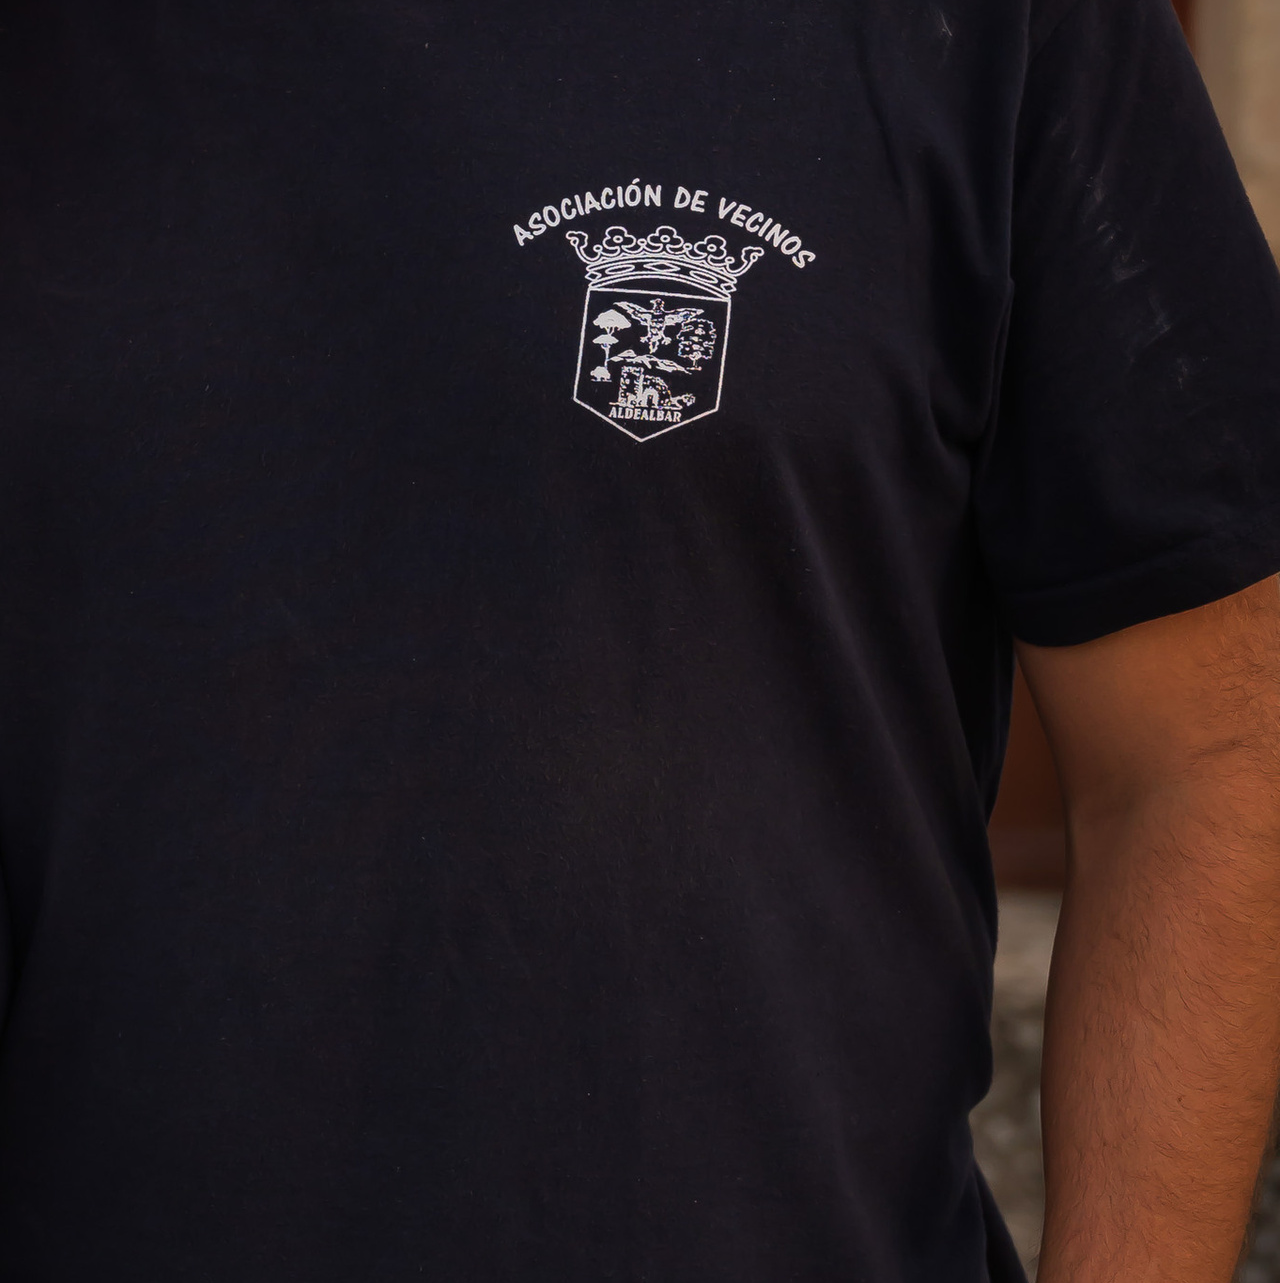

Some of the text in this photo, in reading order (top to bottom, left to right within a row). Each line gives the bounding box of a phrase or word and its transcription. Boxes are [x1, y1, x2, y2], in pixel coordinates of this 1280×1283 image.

[513, 178, 816, 269] ASOCIACIÓN DE VECINOS
[608, 406, 682, 423] ALDEALBAR
